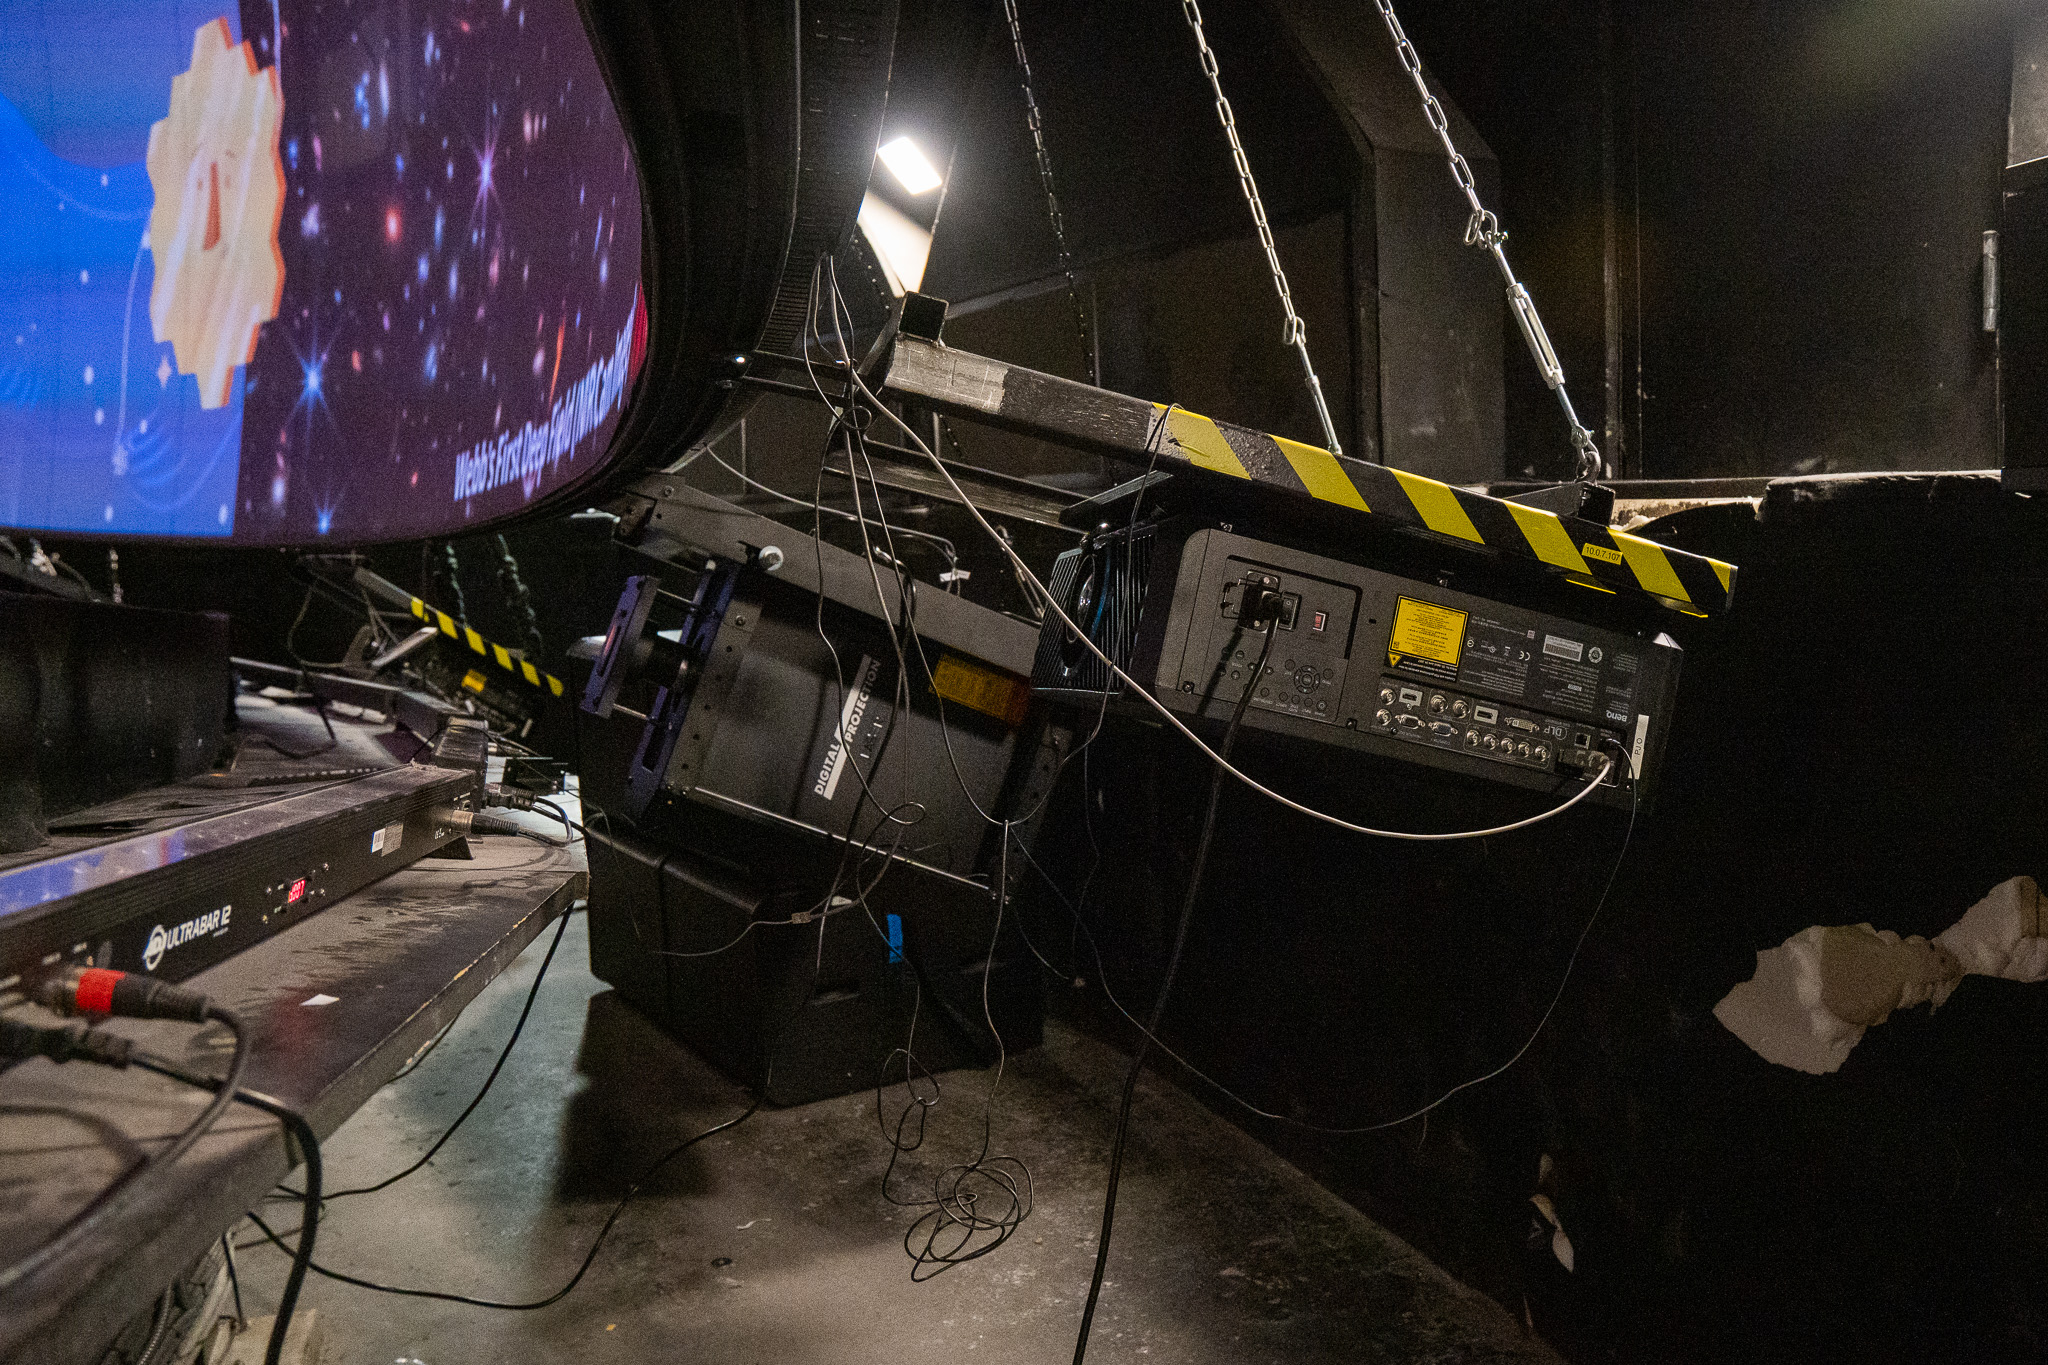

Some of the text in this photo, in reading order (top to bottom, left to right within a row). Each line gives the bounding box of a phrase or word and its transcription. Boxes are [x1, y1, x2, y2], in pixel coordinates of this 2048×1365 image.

[1586, 546, 1620, 561] 10.0.7.107
[1605, 709, 1627, 722] BenQ
[814, 743, 841, 796] DIGITAL
[845, 659, 882, 743] PROJECTION
[1543, 724, 1562, 737] DLP
[165, 909, 221, 950] ULTRABAR
